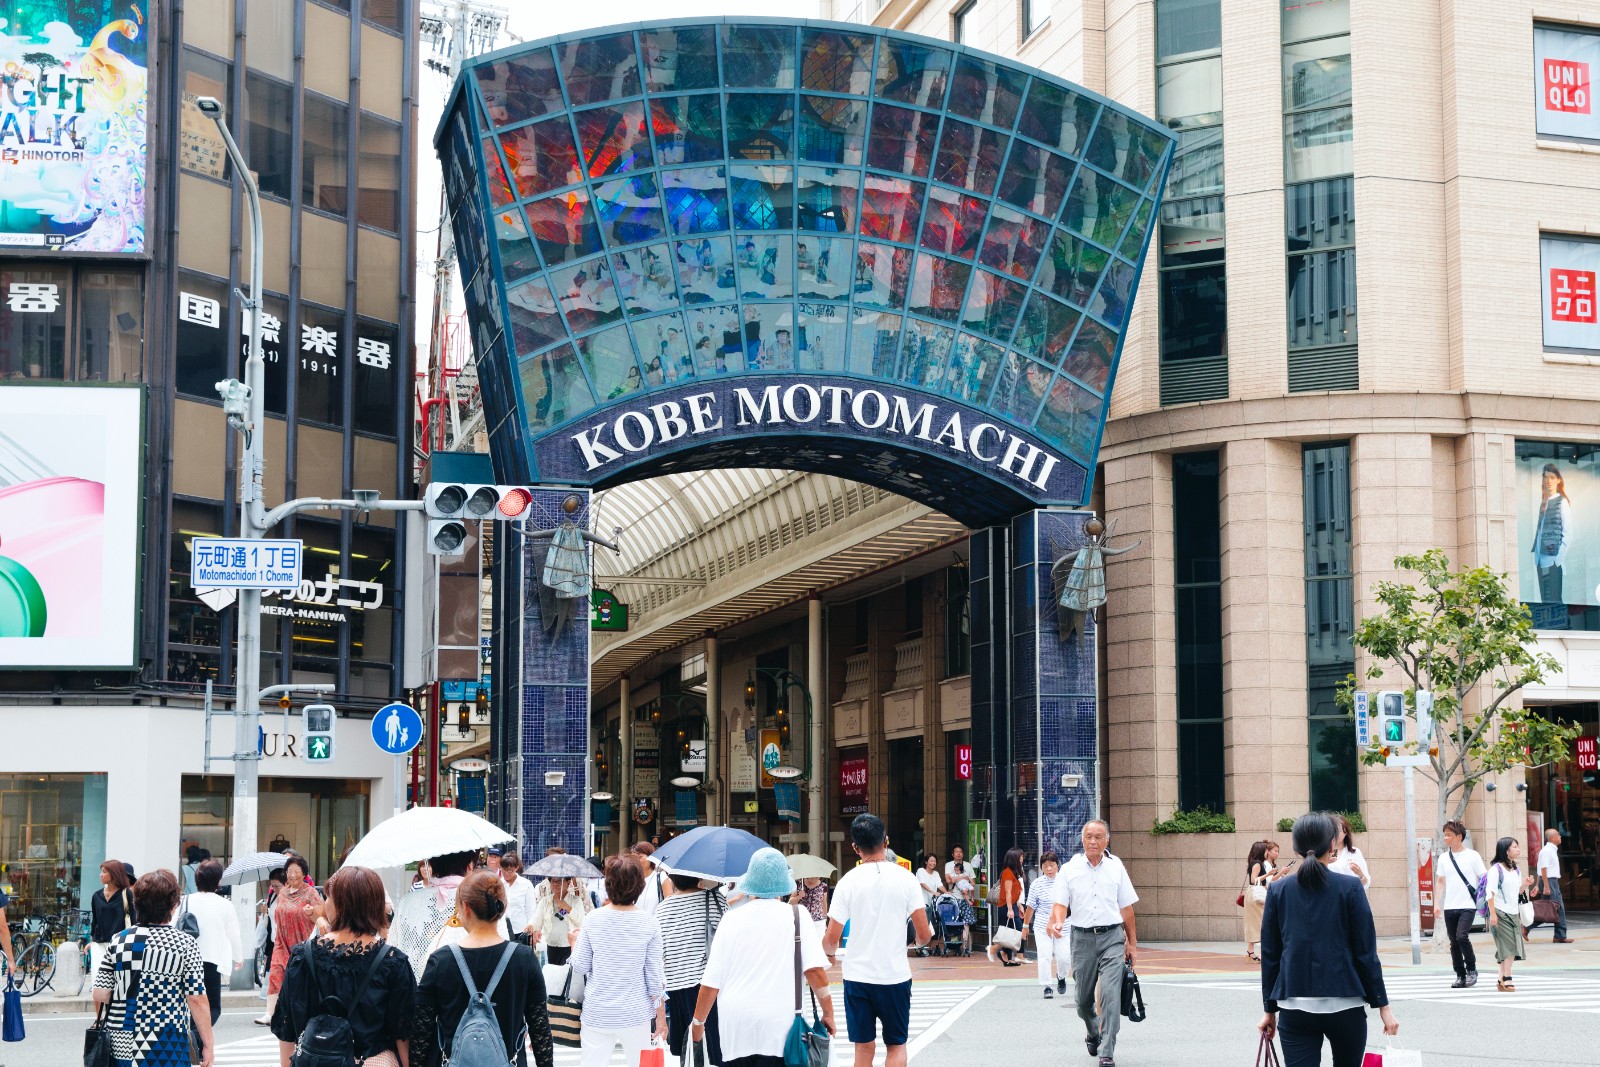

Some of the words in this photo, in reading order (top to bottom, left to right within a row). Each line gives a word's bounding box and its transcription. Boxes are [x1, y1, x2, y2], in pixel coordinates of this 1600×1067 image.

[1548, 65, 1582, 87] UNI
[0, 73, 94, 113] GHT
[1549, 86, 1586, 108] QLO
[0, 110, 87, 149] ALK
[22, 149, 84, 162] HINOTORI
[1556, 274, 1591, 295] ユニ
[5, 282, 61, 313] 器
[1555, 297, 1592, 317] クロ
[302, 358, 337, 377] 1911
[571, 391, 723, 471] KOBE
[732, 383, 1060, 492] MOTOMACHI
[199, 568, 257, 582] Motomachidori
[259, 570, 264, 581] 1
[266, 570, 294, 582] Chome
[1578, 740, 1594, 753] UNI
[1578, 754, 1596, 769] QLO
